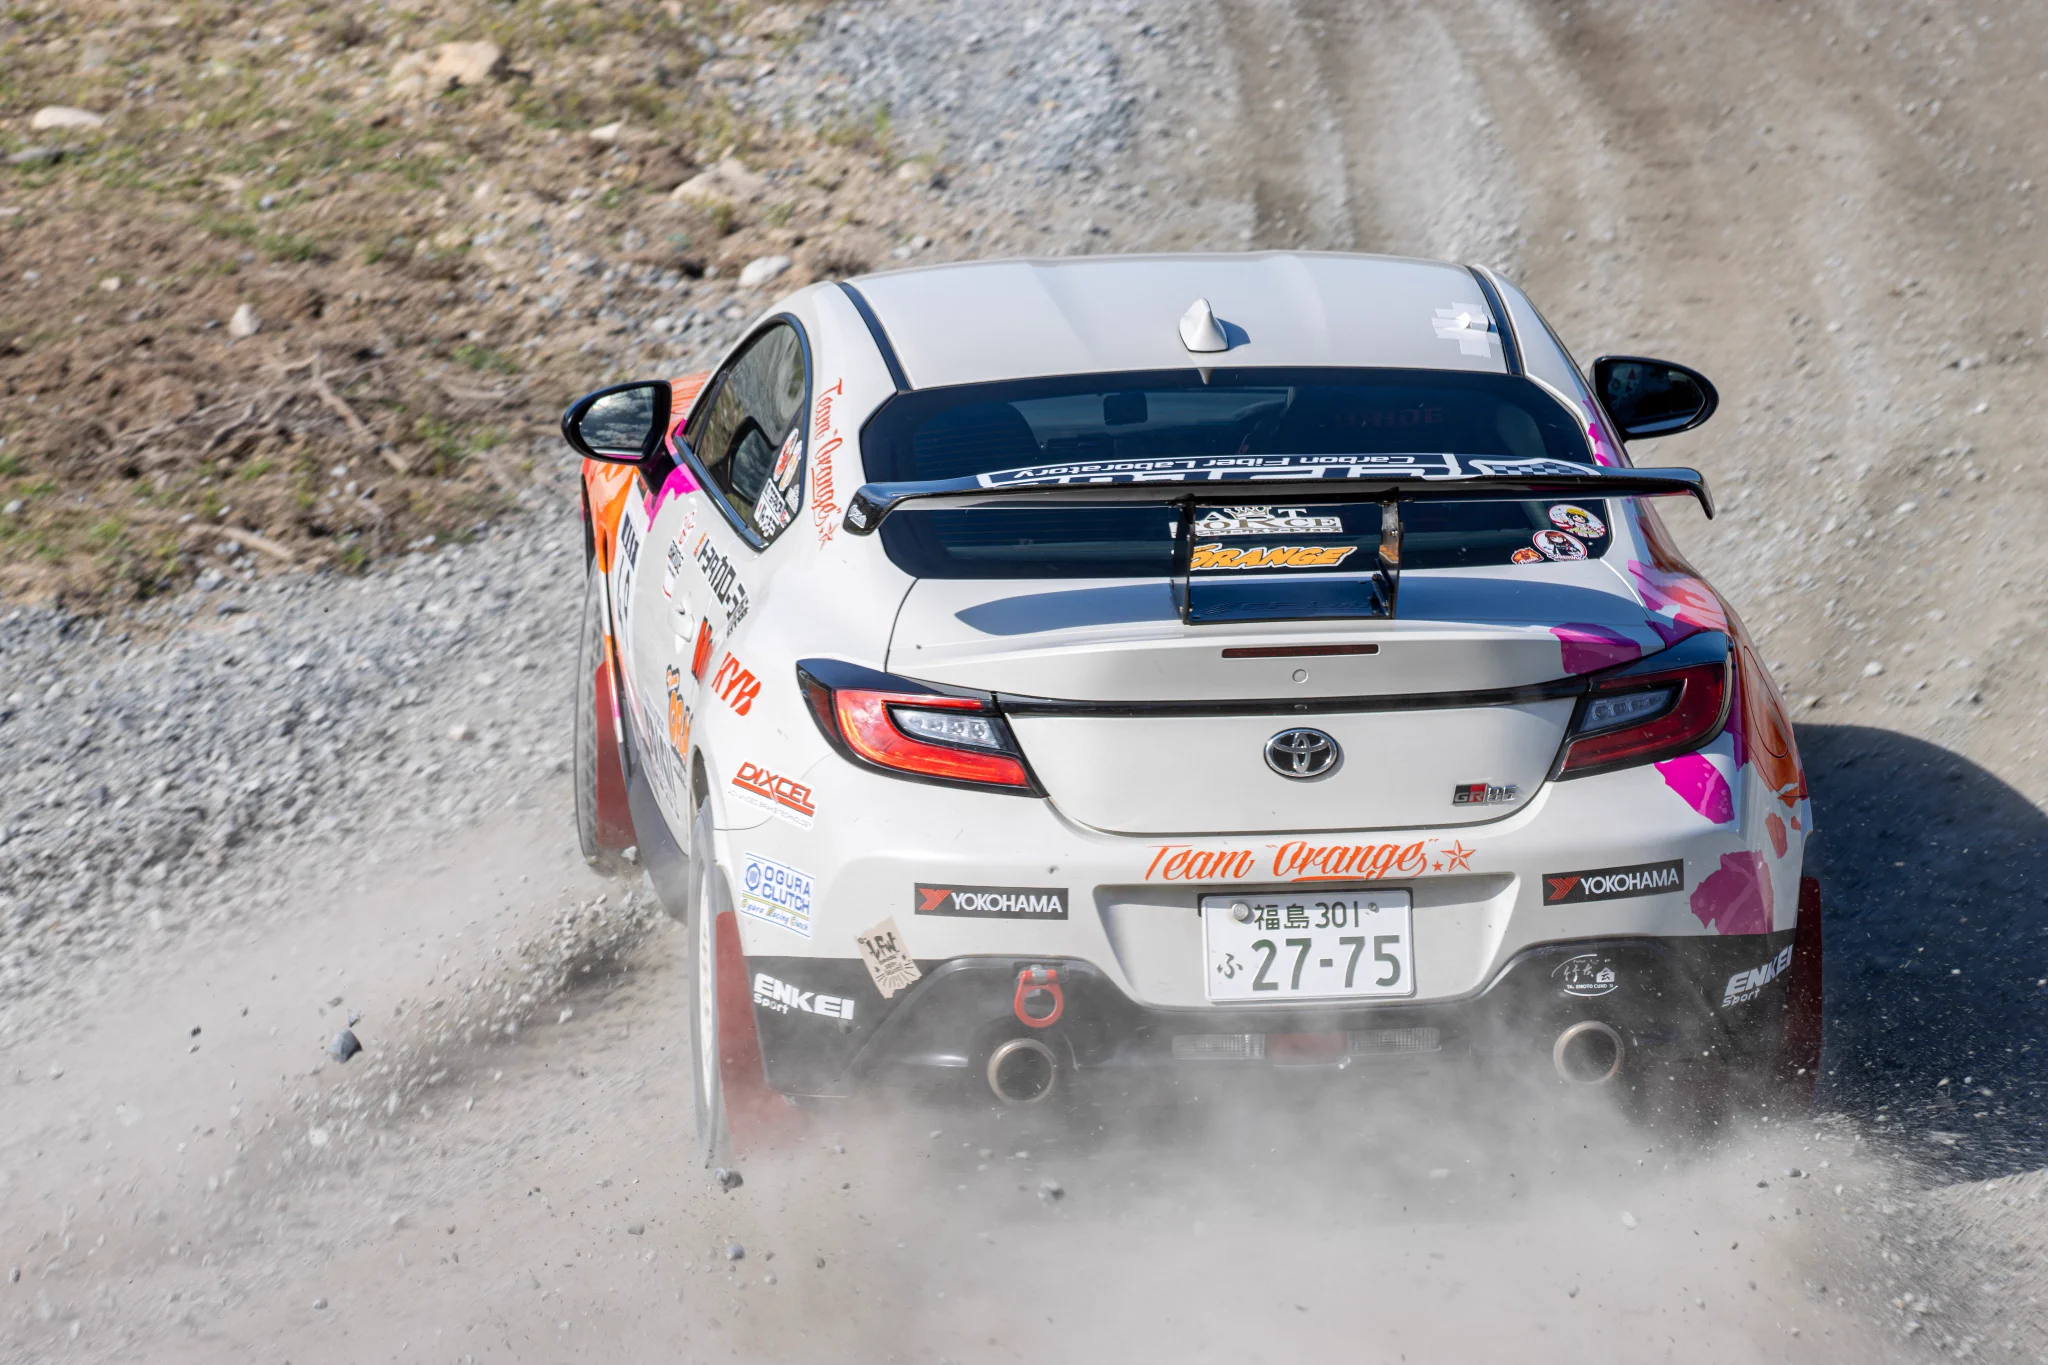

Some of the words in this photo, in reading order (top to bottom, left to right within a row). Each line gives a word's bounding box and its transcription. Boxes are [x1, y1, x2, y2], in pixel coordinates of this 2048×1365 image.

[813, 377, 843, 440] Team
[1012, 459, 1196, 480] Laboratory
[1204, 456, 1289, 468] Fiber
[1299, 455, 1415, 466] Carbon
[1195, 516, 1338, 529] ORCE
[711, 651, 762, 716] KYB
[736, 761, 815, 809] DIXCEL
[1454, 791, 1484, 802] GR
[1486, 785, 1516, 803] 86
[1144, 844, 1256, 881] Team
[764, 866, 810, 897] OGURA
[1581, 868, 1680, 895] YOKOHAMA
[762, 883, 810, 915] CLUTCH
[951, 892, 1063, 913] YOKOHAMA
[1254, 903, 1310, 930] 福島
[1315, 901, 1360, 929] 301
[1217, 953, 1243, 979] ふ
[1251, 935, 1401, 992] 27-75
[1724, 943, 1793, 996] ENKEI
[753, 993, 789, 1014] Sport
[754, 973, 855, 1020] ENKEI
[1721, 987, 1760, 1008] Sport
